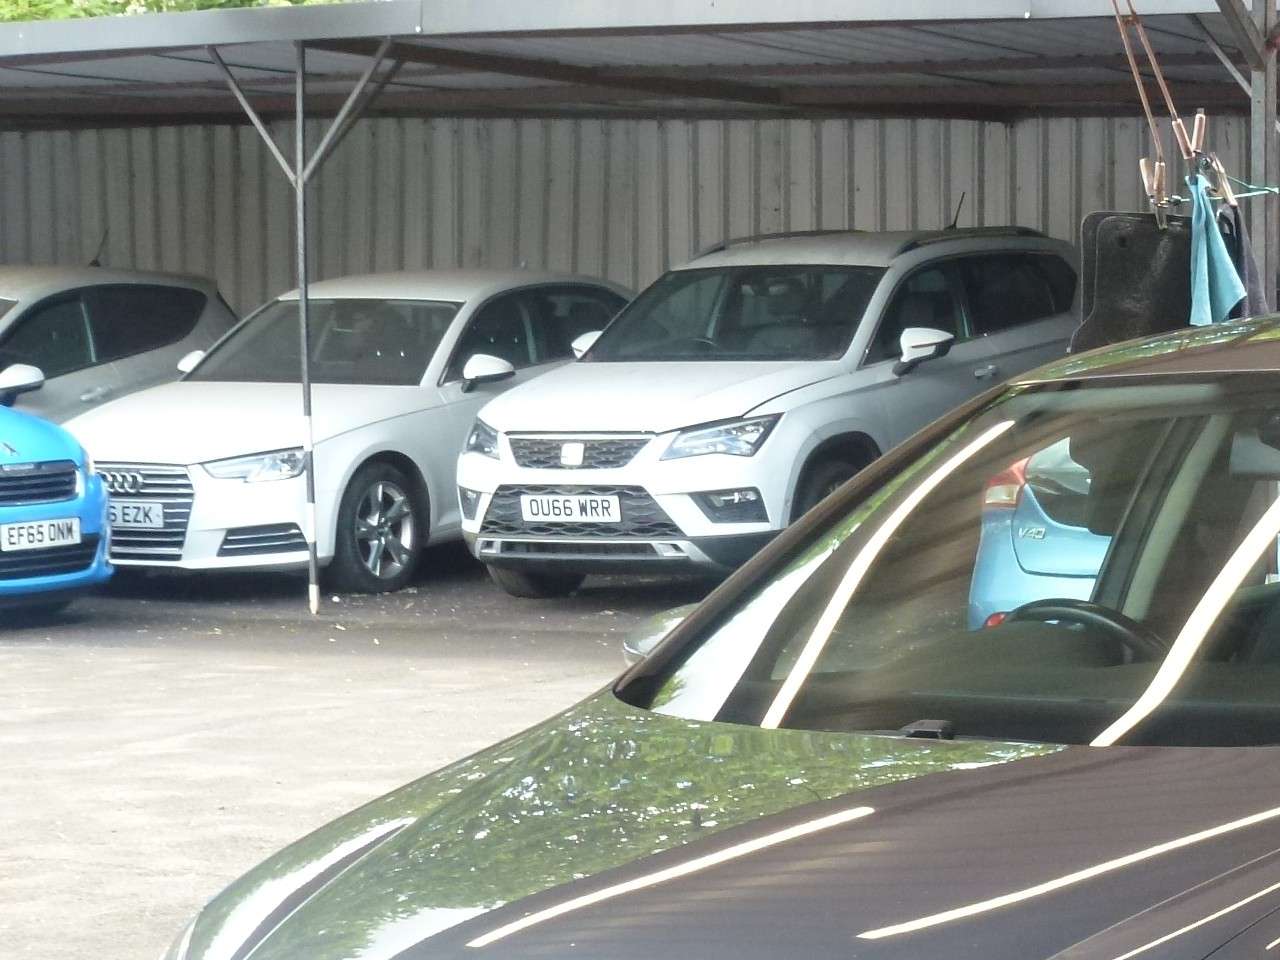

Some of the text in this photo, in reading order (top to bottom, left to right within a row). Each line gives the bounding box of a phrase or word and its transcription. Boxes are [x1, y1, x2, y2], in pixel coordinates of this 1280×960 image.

[122, 505, 153, 523] EZK
[529, 498, 611, 517] OU66 WRR
[8, 524, 44, 546] EF65
[1018, 527, 1046, 540] V40
